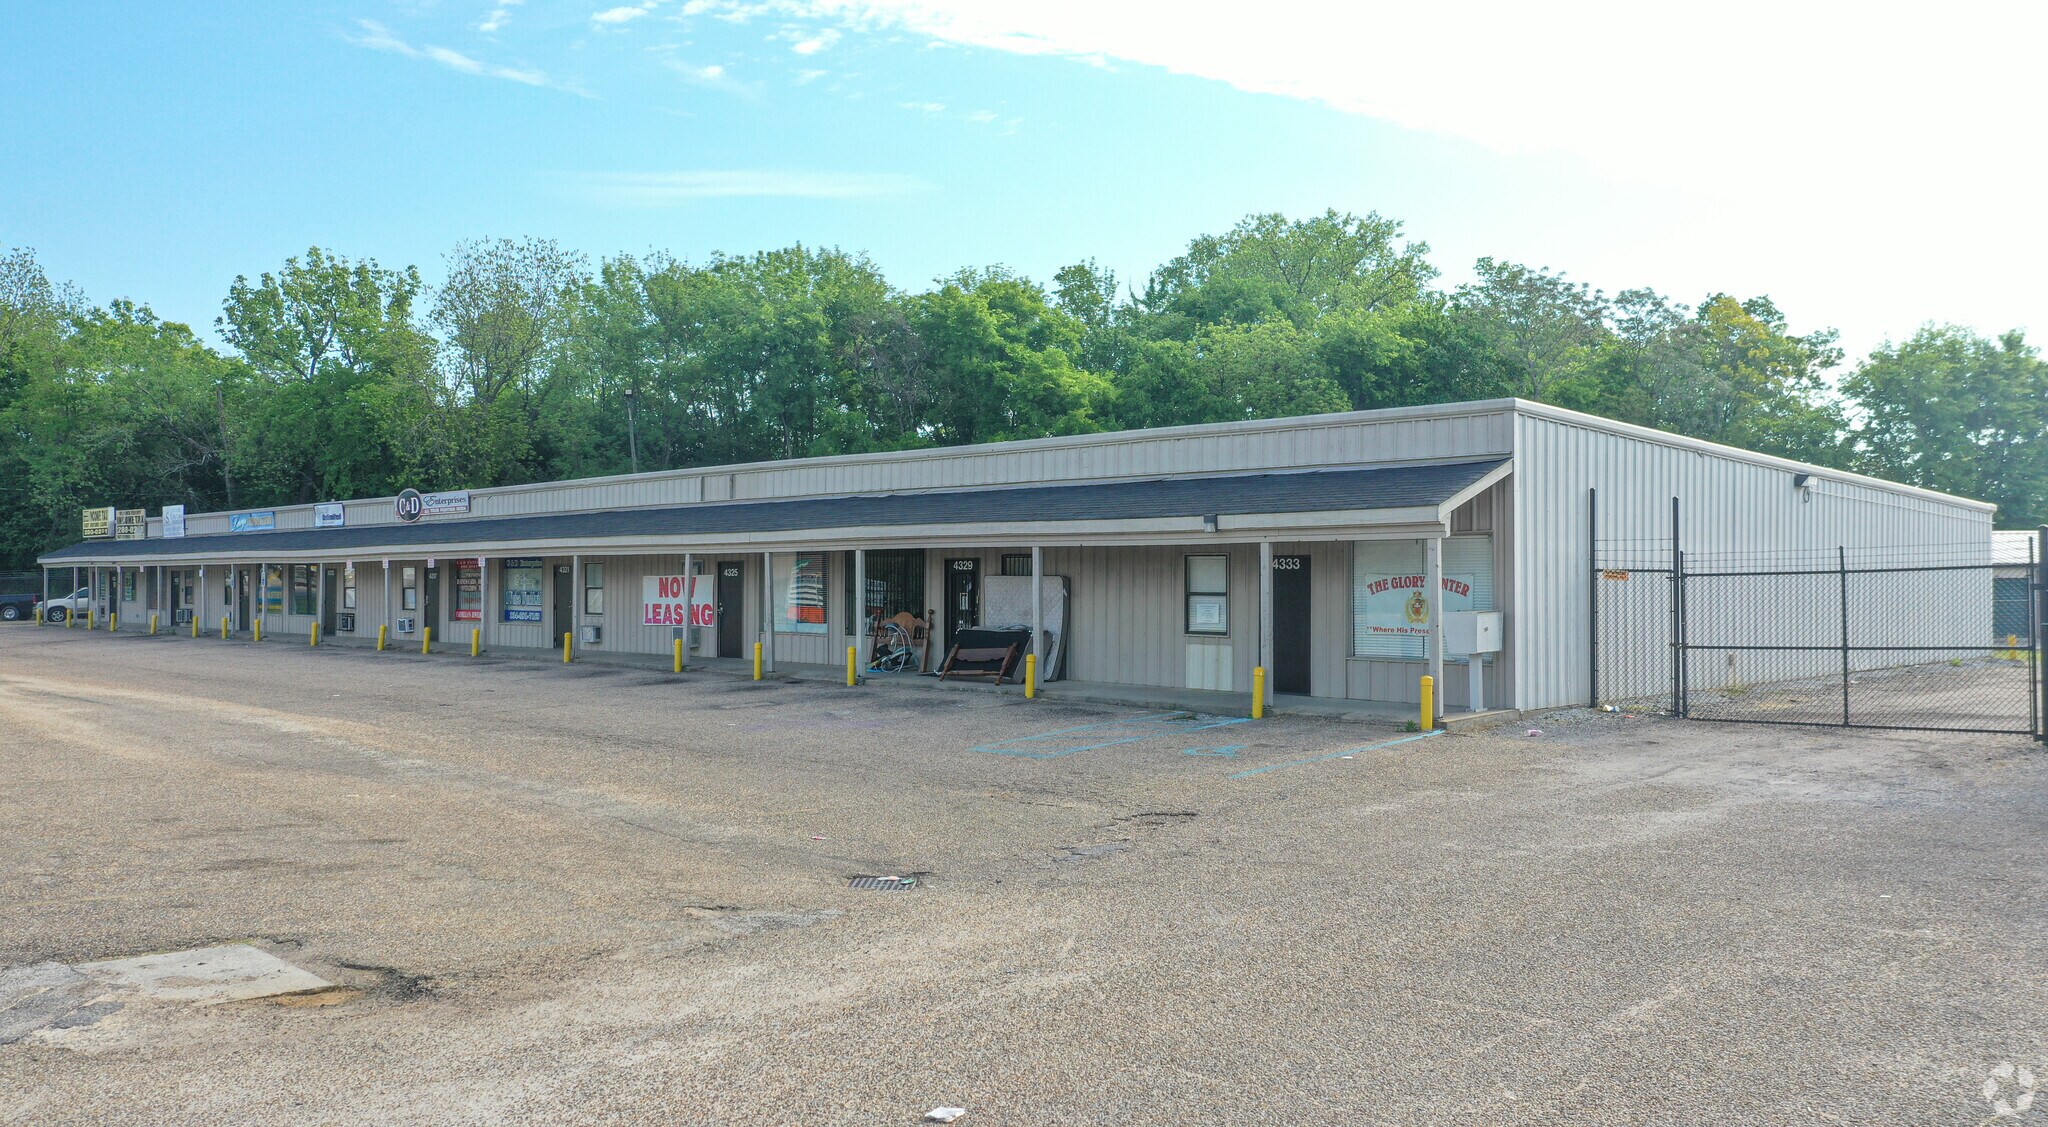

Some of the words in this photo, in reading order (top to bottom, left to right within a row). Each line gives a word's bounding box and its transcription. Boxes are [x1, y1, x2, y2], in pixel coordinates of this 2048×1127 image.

[423, 495, 467, 507] Enterprises
[953, 560, 973, 570] 4329
[1272, 558, 1300, 570] 4333
[723, 568, 739, 577] 4325
[1366, 578, 1389, 596] THE
[1391, 576, 1426, 590] GLORY
[1441, 577, 1470, 597] NTER
[644, 603, 714, 626] LEASNG
